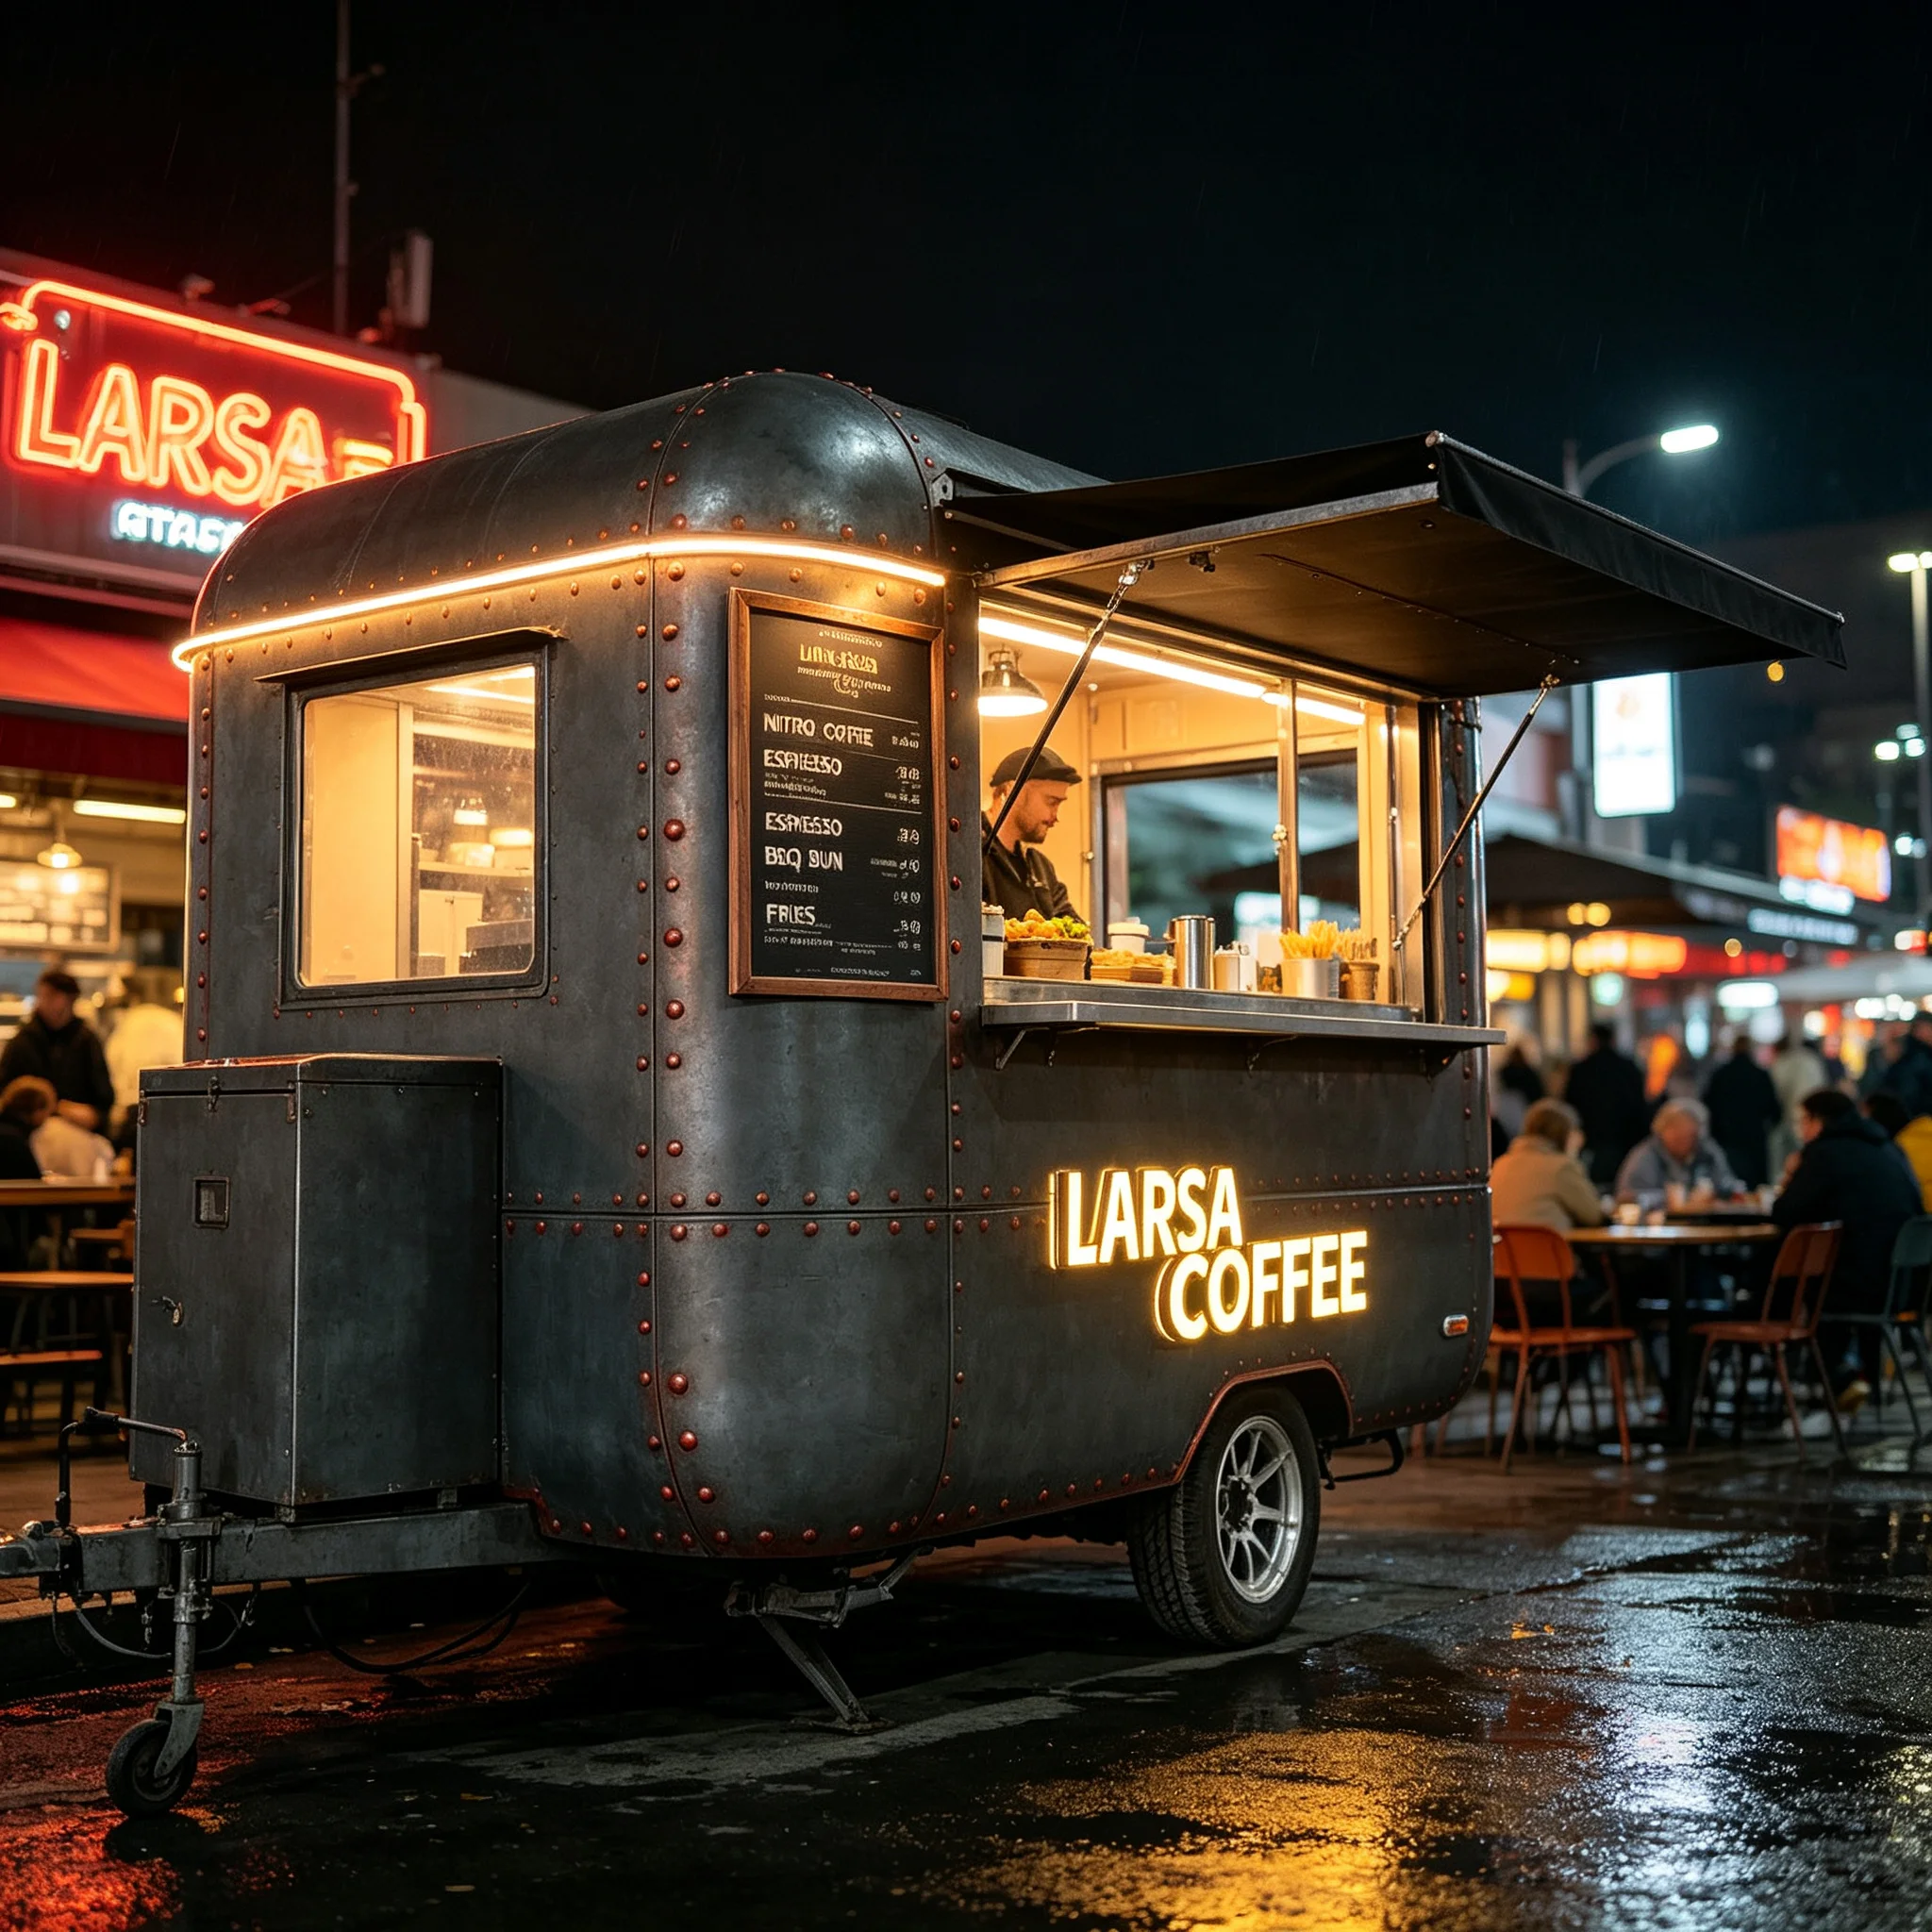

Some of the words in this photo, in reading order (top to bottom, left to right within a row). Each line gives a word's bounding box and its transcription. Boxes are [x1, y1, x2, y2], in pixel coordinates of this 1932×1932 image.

[17, 337, 327, 508] LARSA
[763, 712, 816, 737] NITRO
[1049, 1165, 1243, 1269] LARSA
[1157, 1230, 1368, 1341] COFFEE
